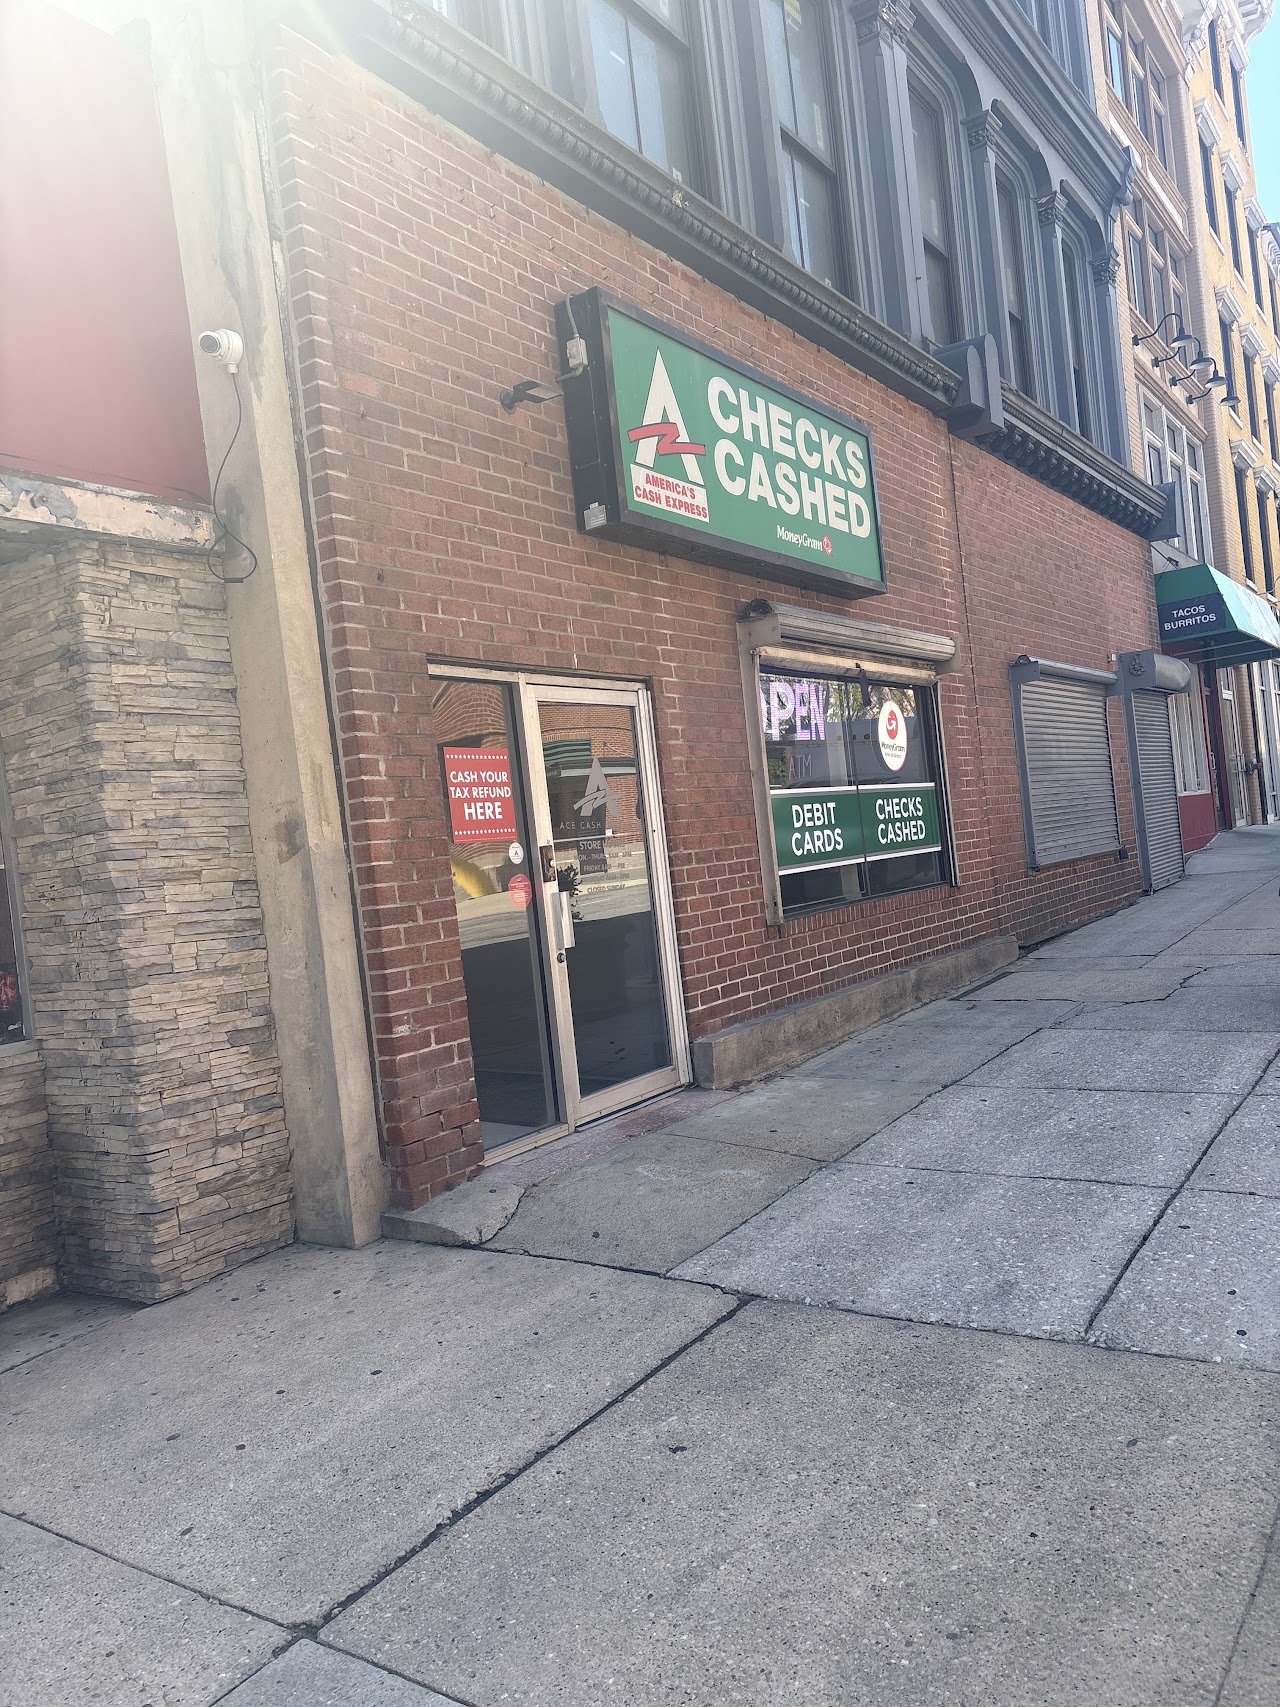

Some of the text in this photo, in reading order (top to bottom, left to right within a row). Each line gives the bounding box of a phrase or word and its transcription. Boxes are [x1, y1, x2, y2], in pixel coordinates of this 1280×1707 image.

[708, 376, 867, 489] CHECKS
[645, 472, 696, 500] AMERICA'S
[714, 439, 871, 539] CASHED
[635, 485, 708, 519] CASH EXPRESS
[776, 524, 823, 552] MoneyGram
[1164, 613, 1217, 631] BURRITOS
[1171, 604, 1206, 619] TACOS
[449, 770, 509, 783] CASH YOUR
[788, 753, 812, 780] ATM
[449, 786, 512, 799] TAX REFUND
[463, 801, 503, 821] HERE
[791, 801, 837, 829] DEBIT
[876, 796, 923, 821] CHECKS
[560, 821, 576, 830] ACE
[580, 821, 602, 830] CASH
[877, 819, 926, 845] CASHED
[579, 840, 602, 850] STORE
[791, 827, 844, 857] CARDS
[586, 883, 626, 894] CLOSED SUNDAY
